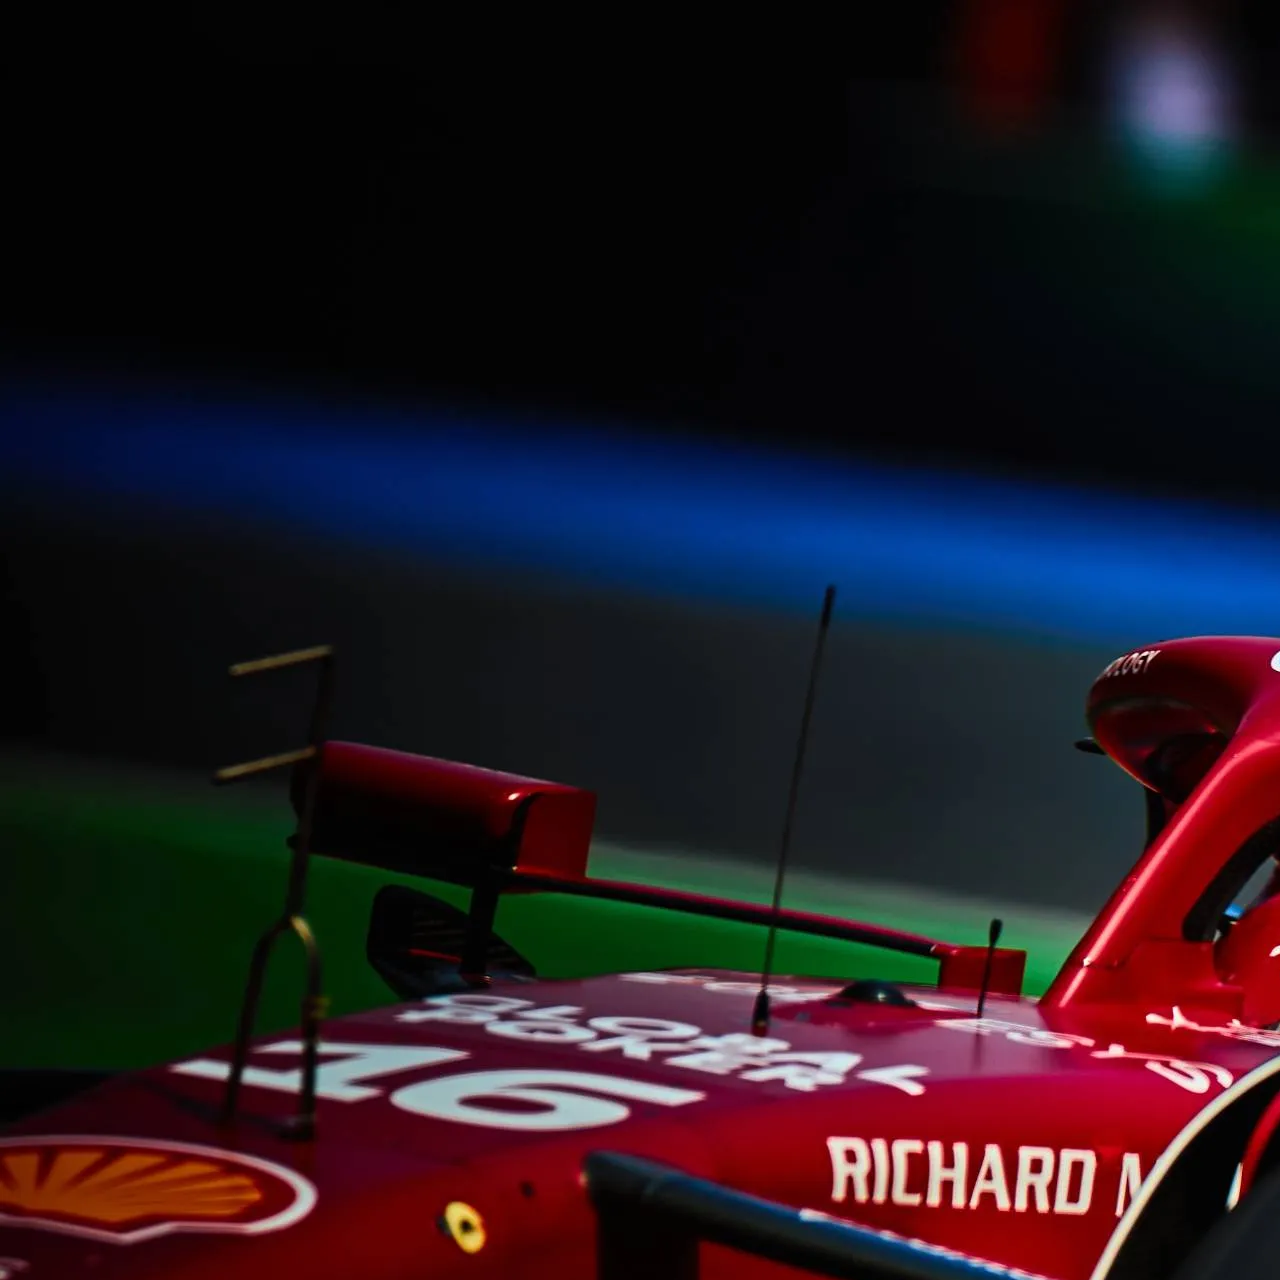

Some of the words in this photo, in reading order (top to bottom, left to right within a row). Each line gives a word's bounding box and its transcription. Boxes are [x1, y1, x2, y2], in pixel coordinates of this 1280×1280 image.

[1102, 650, 1161, 677] OLOGY
[172, 1040, 706, 1131] 16
[827, 1136, 1097, 1216] RICHARD
